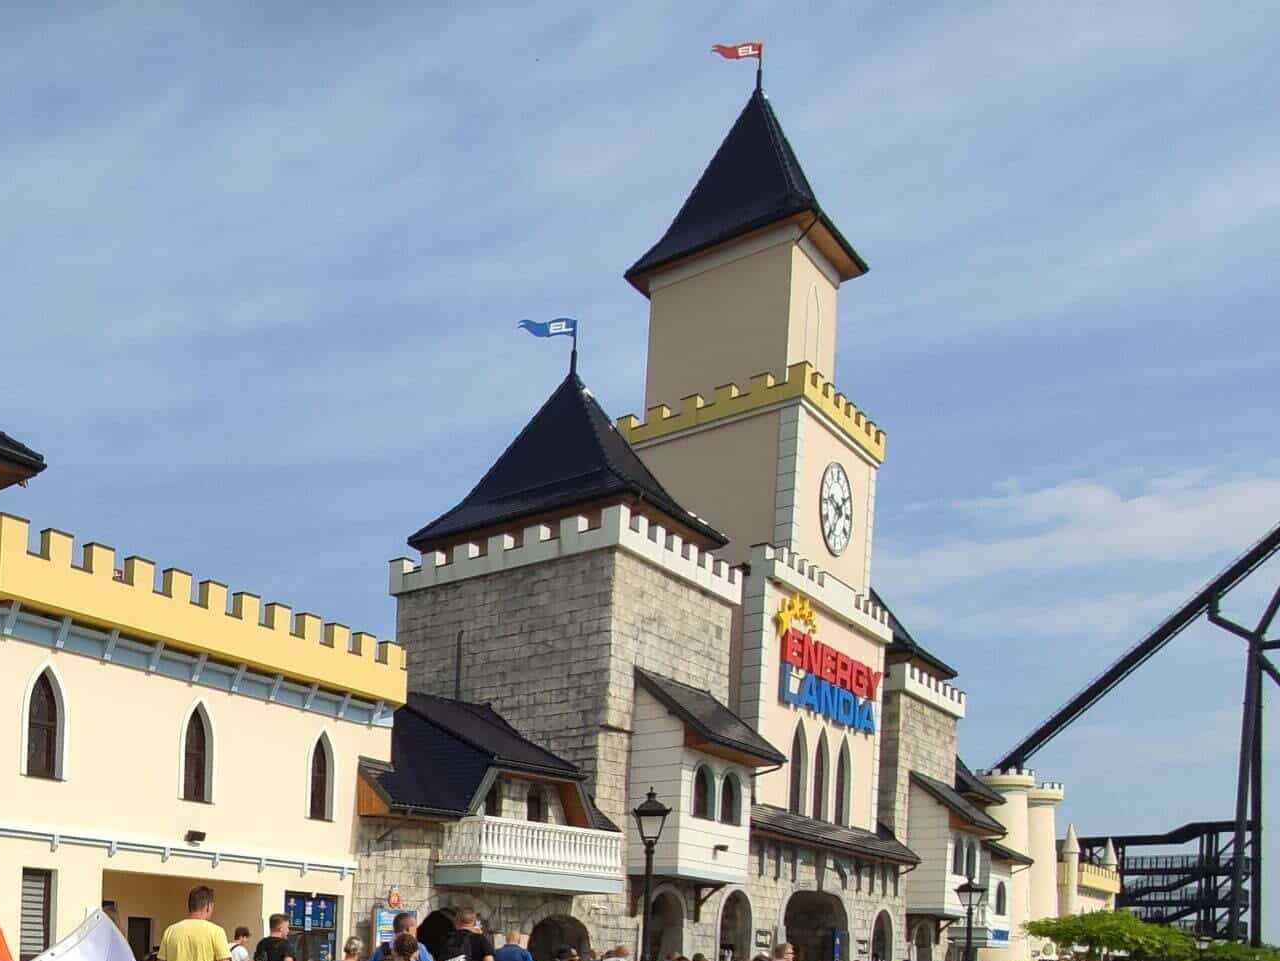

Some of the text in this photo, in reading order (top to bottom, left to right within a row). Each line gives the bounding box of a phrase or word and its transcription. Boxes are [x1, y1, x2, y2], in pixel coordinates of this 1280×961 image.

[738, 45, 759, 57] EL
[550, 321, 574, 334] EL
[781, 627, 882, 702] ENERGY
[779, 663, 876, 736] LANDIA
